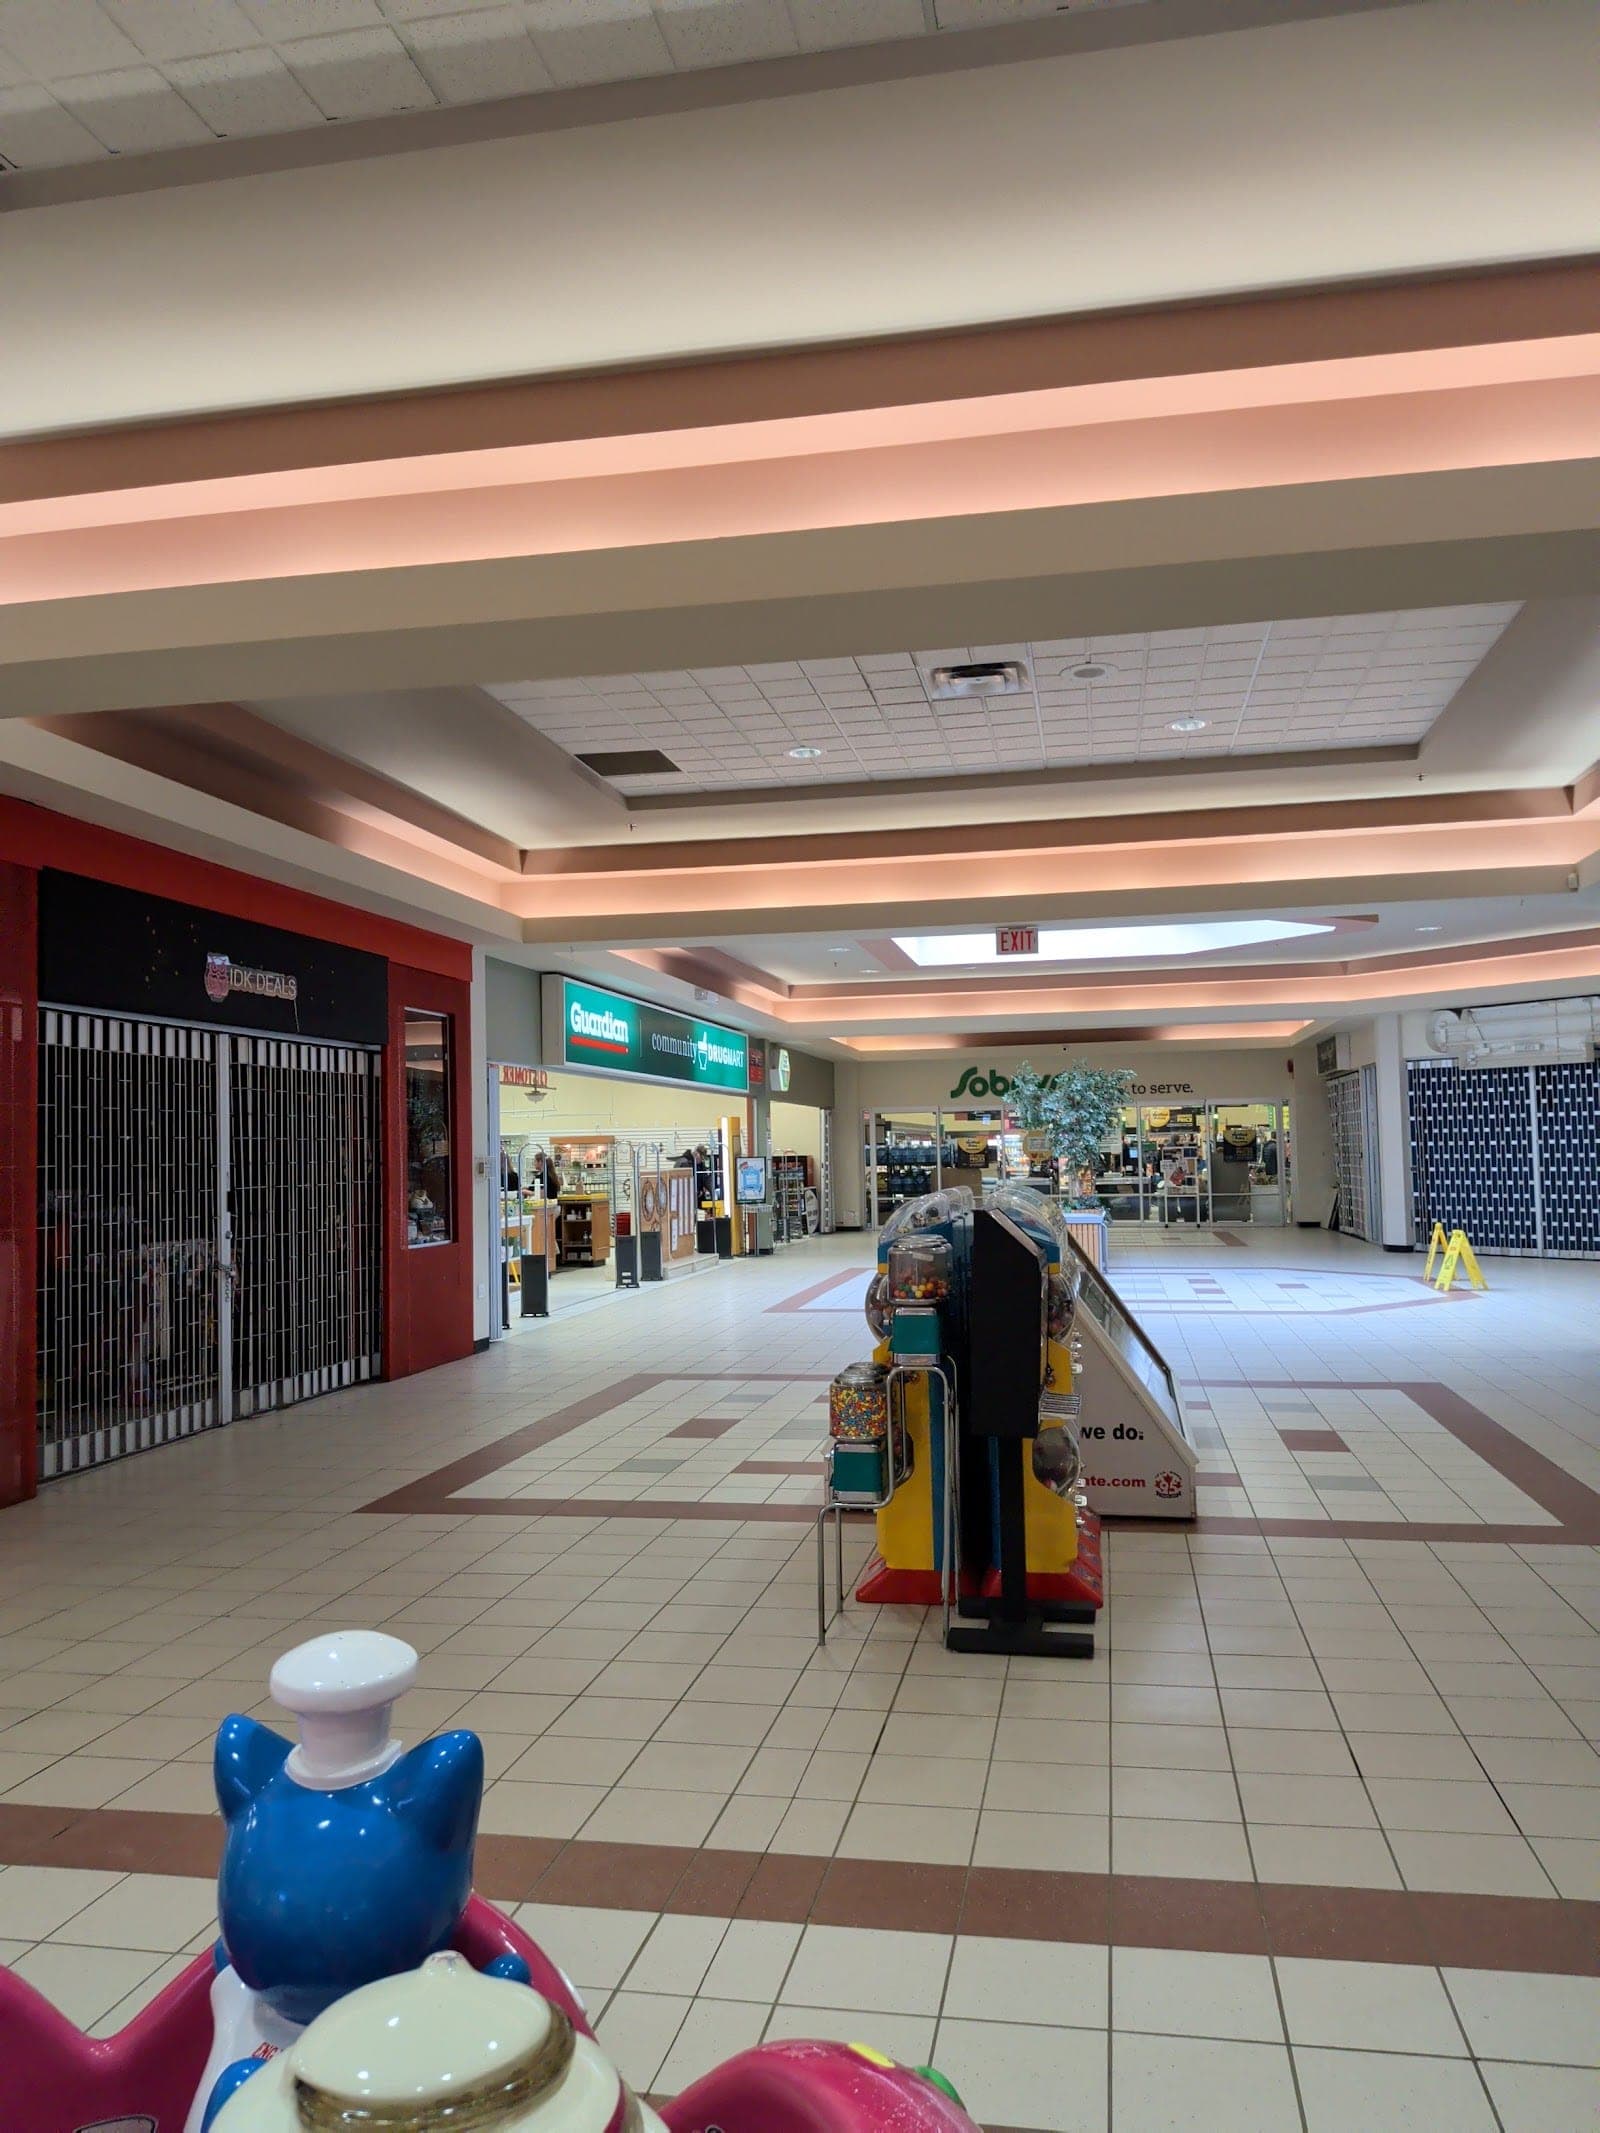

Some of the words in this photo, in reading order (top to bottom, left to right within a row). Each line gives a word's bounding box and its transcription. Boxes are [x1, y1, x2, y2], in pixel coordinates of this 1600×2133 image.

[1001, 930, 1033, 951] EXIT
[230, 968, 253, 989] IDK
[256, 973, 297, 998] DEALS
[570, 1001, 629, 1043] Guardian
[651, 1032, 698, 1064] community
[707, 1043, 744, 1067] DRUGMART
[1131, 1083, 1146, 1094] to
[1150, 1082, 1193, 1094] serve.
